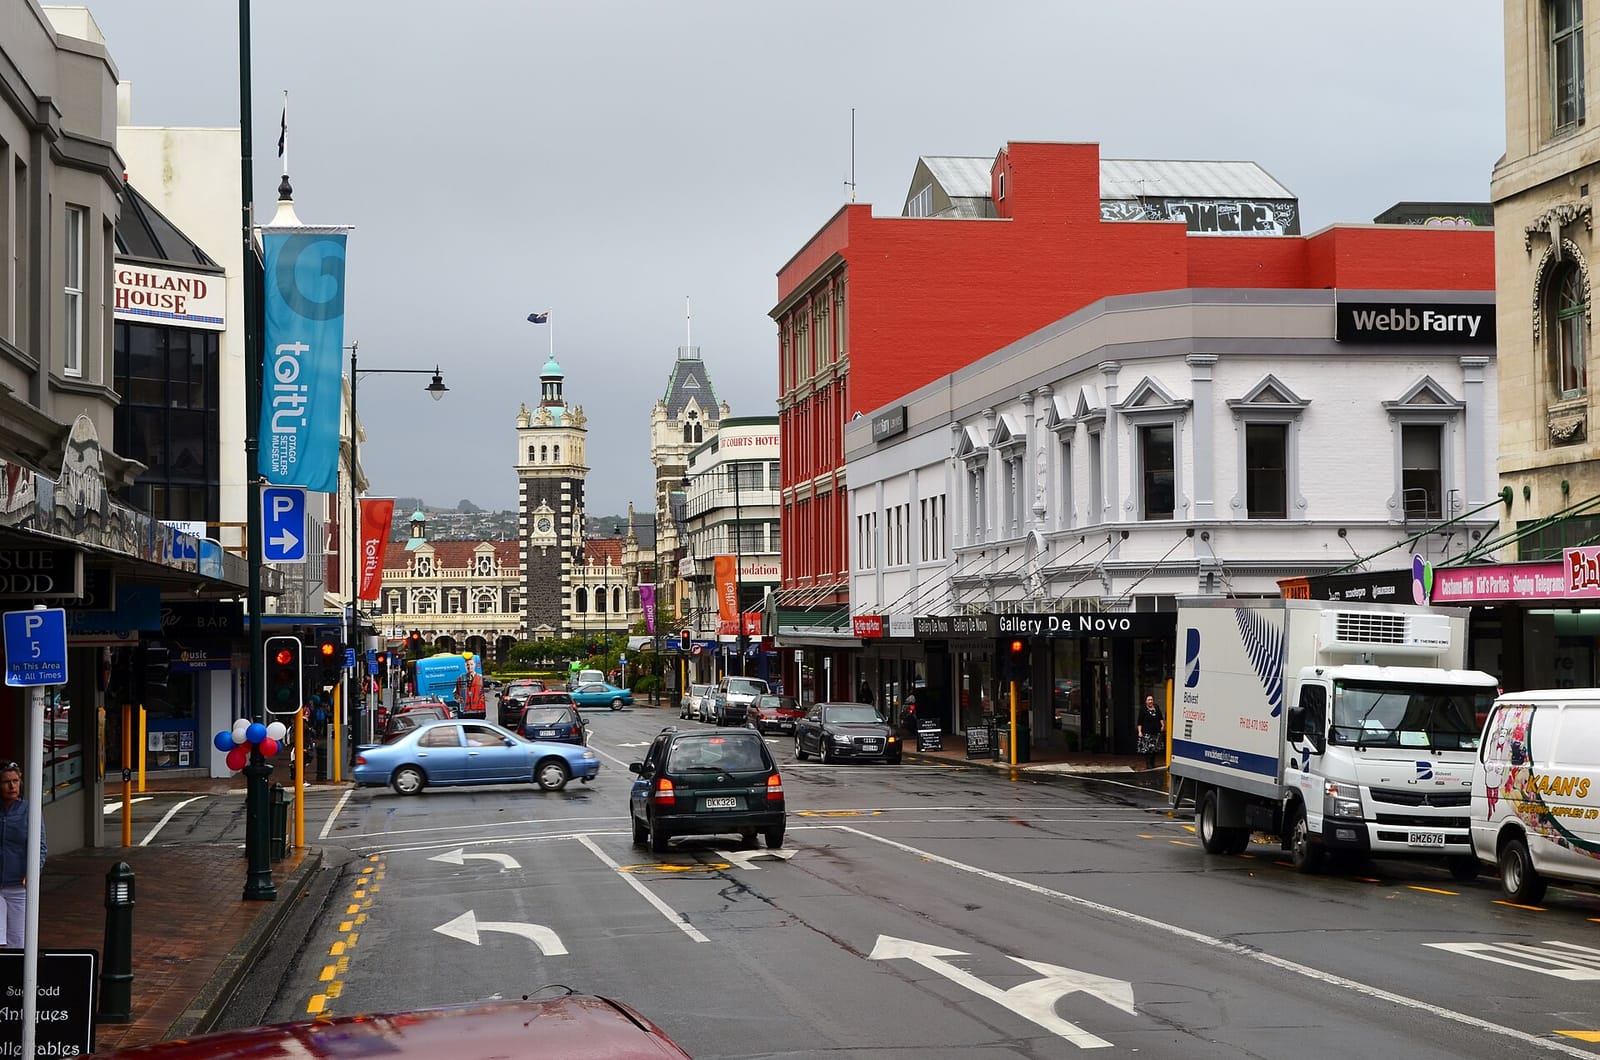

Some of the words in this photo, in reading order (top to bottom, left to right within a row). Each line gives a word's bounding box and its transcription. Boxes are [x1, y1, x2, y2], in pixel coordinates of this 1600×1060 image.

[115, 287, 187, 314] HOUSE
[288, 435, 297, 463] OTAGO
[727, 437, 753, 447] COURTS
[271, 435, 280, 472] MUSEUM
[280, 435, 288, 476] SETTLERS
[273, 496, 294, 522] P
[0, 550, 54, 569] SUE
[1569, 550, 1600, 592] Pin
[1441, 578, 1462, 595] Costume
[1462, 577, 1474, 595] Hire
[1476, 576, 1489, 594] Kid's
[1489, 575, 1510, 594] Parties
[1513, 575, 1534, 596] Singing
[1534, 574, 1565, 596] Telegrams
[25, 615, 43, 638] P
[197, 616, 228, 628] BAR
[918, 619, 932, 636] Gallery
[931, 619, 938, 632] De
[938, 620, 949, 632] Novo
[953, 618, 968, 635] Gallery
[968, 617, 976, 632] De
[976, 618, 988, 632] Novo
[1000, 616, 1042, 635] Gallery
[1048, 616, 1071, 631] De
[1080, 616, 1131, 631] Novo
[31, 641, 40, 658] 5
[12, 673, 21, 681] At
[25, 672, 36, 680] All
[39, 671, 62, 679] Times
[13, 663, 20, 671] In
[42, 662, 61, 670] Area
[1526, 774, 1591, 798] KAAN'S
[1410, 833, 1443, 844] GMZ676
